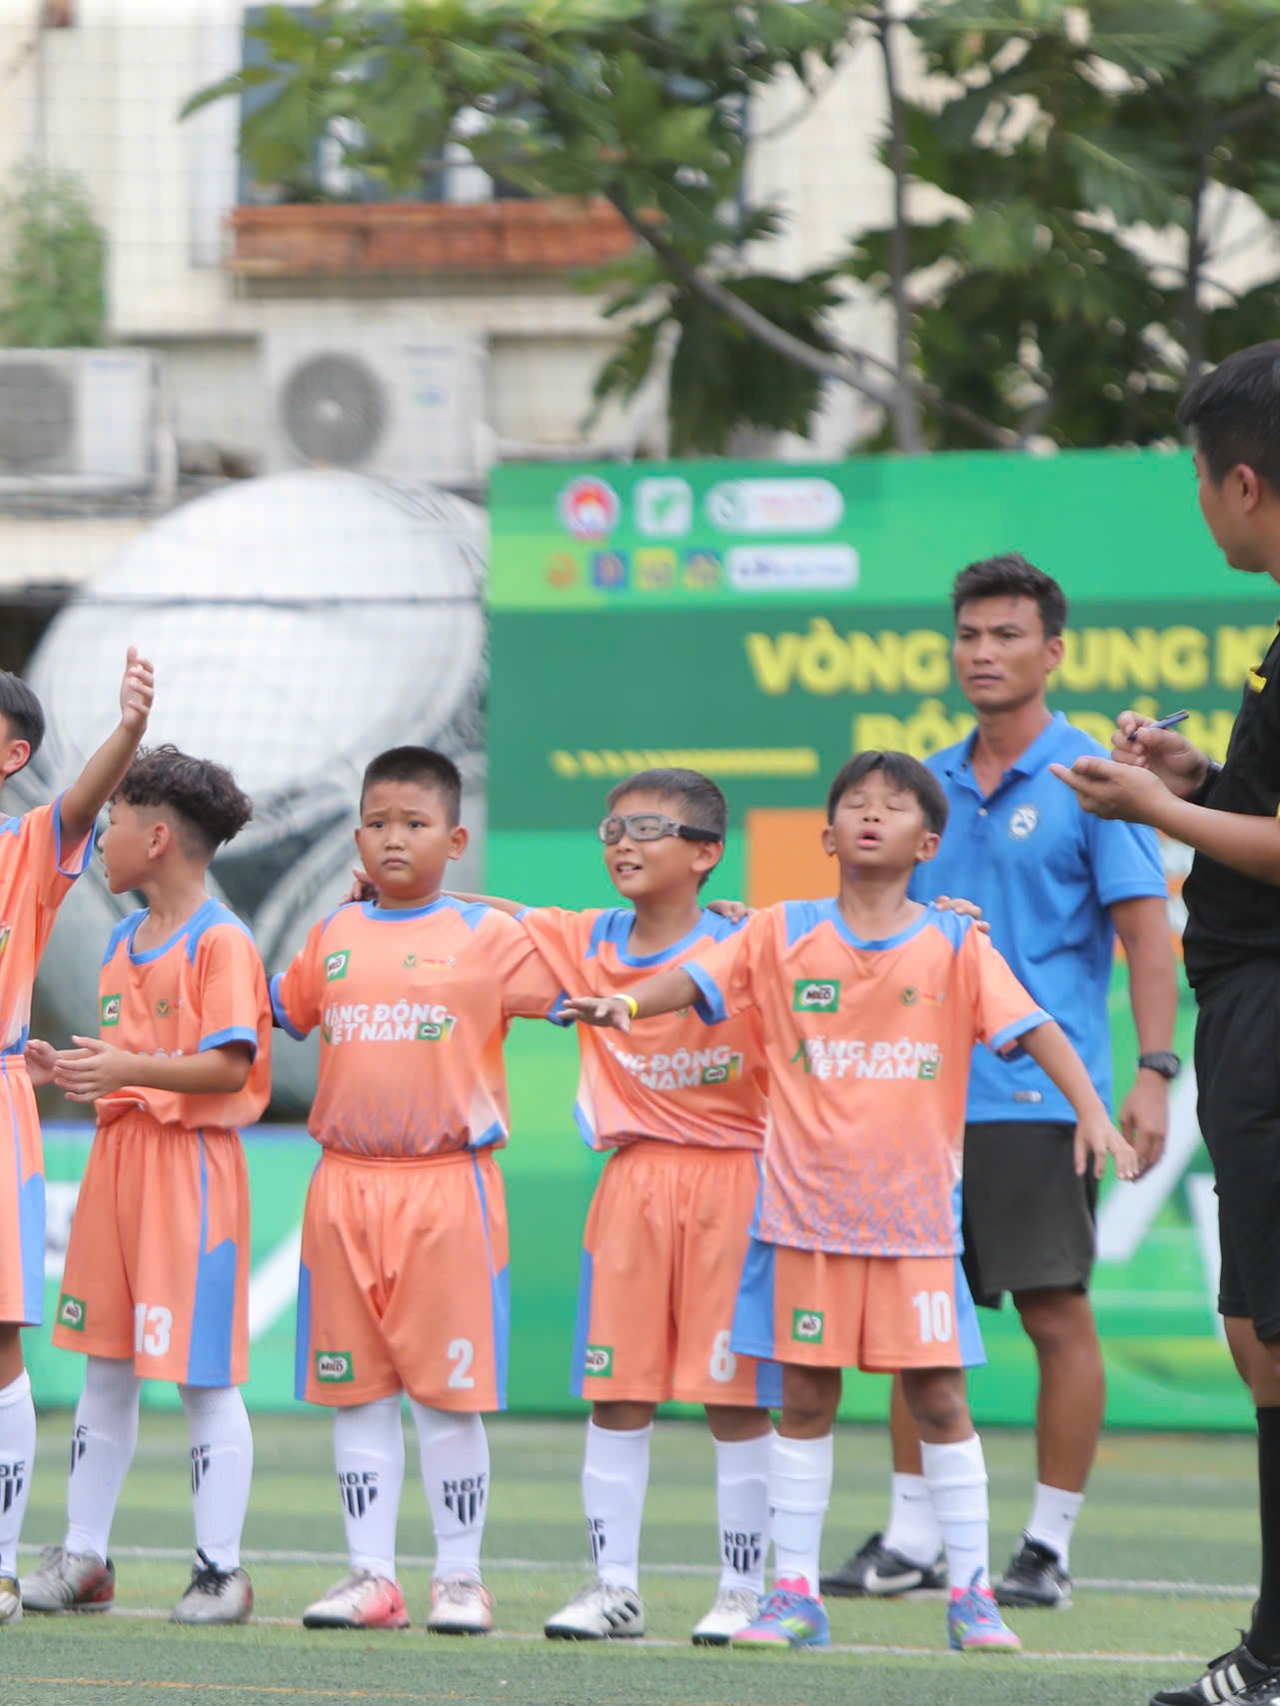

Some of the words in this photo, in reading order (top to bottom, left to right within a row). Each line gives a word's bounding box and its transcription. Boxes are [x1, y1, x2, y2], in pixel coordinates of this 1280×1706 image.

[1047, 625, 1208, 691] UNG
[359, 1021, 418, 1041] NAM
[854, 1058, 921, 1079] NAM
[134, 1302, 173, 1357] 13
[912, 1290, 953, 1344] 10
[446, 1337, 476, 1389] 2
